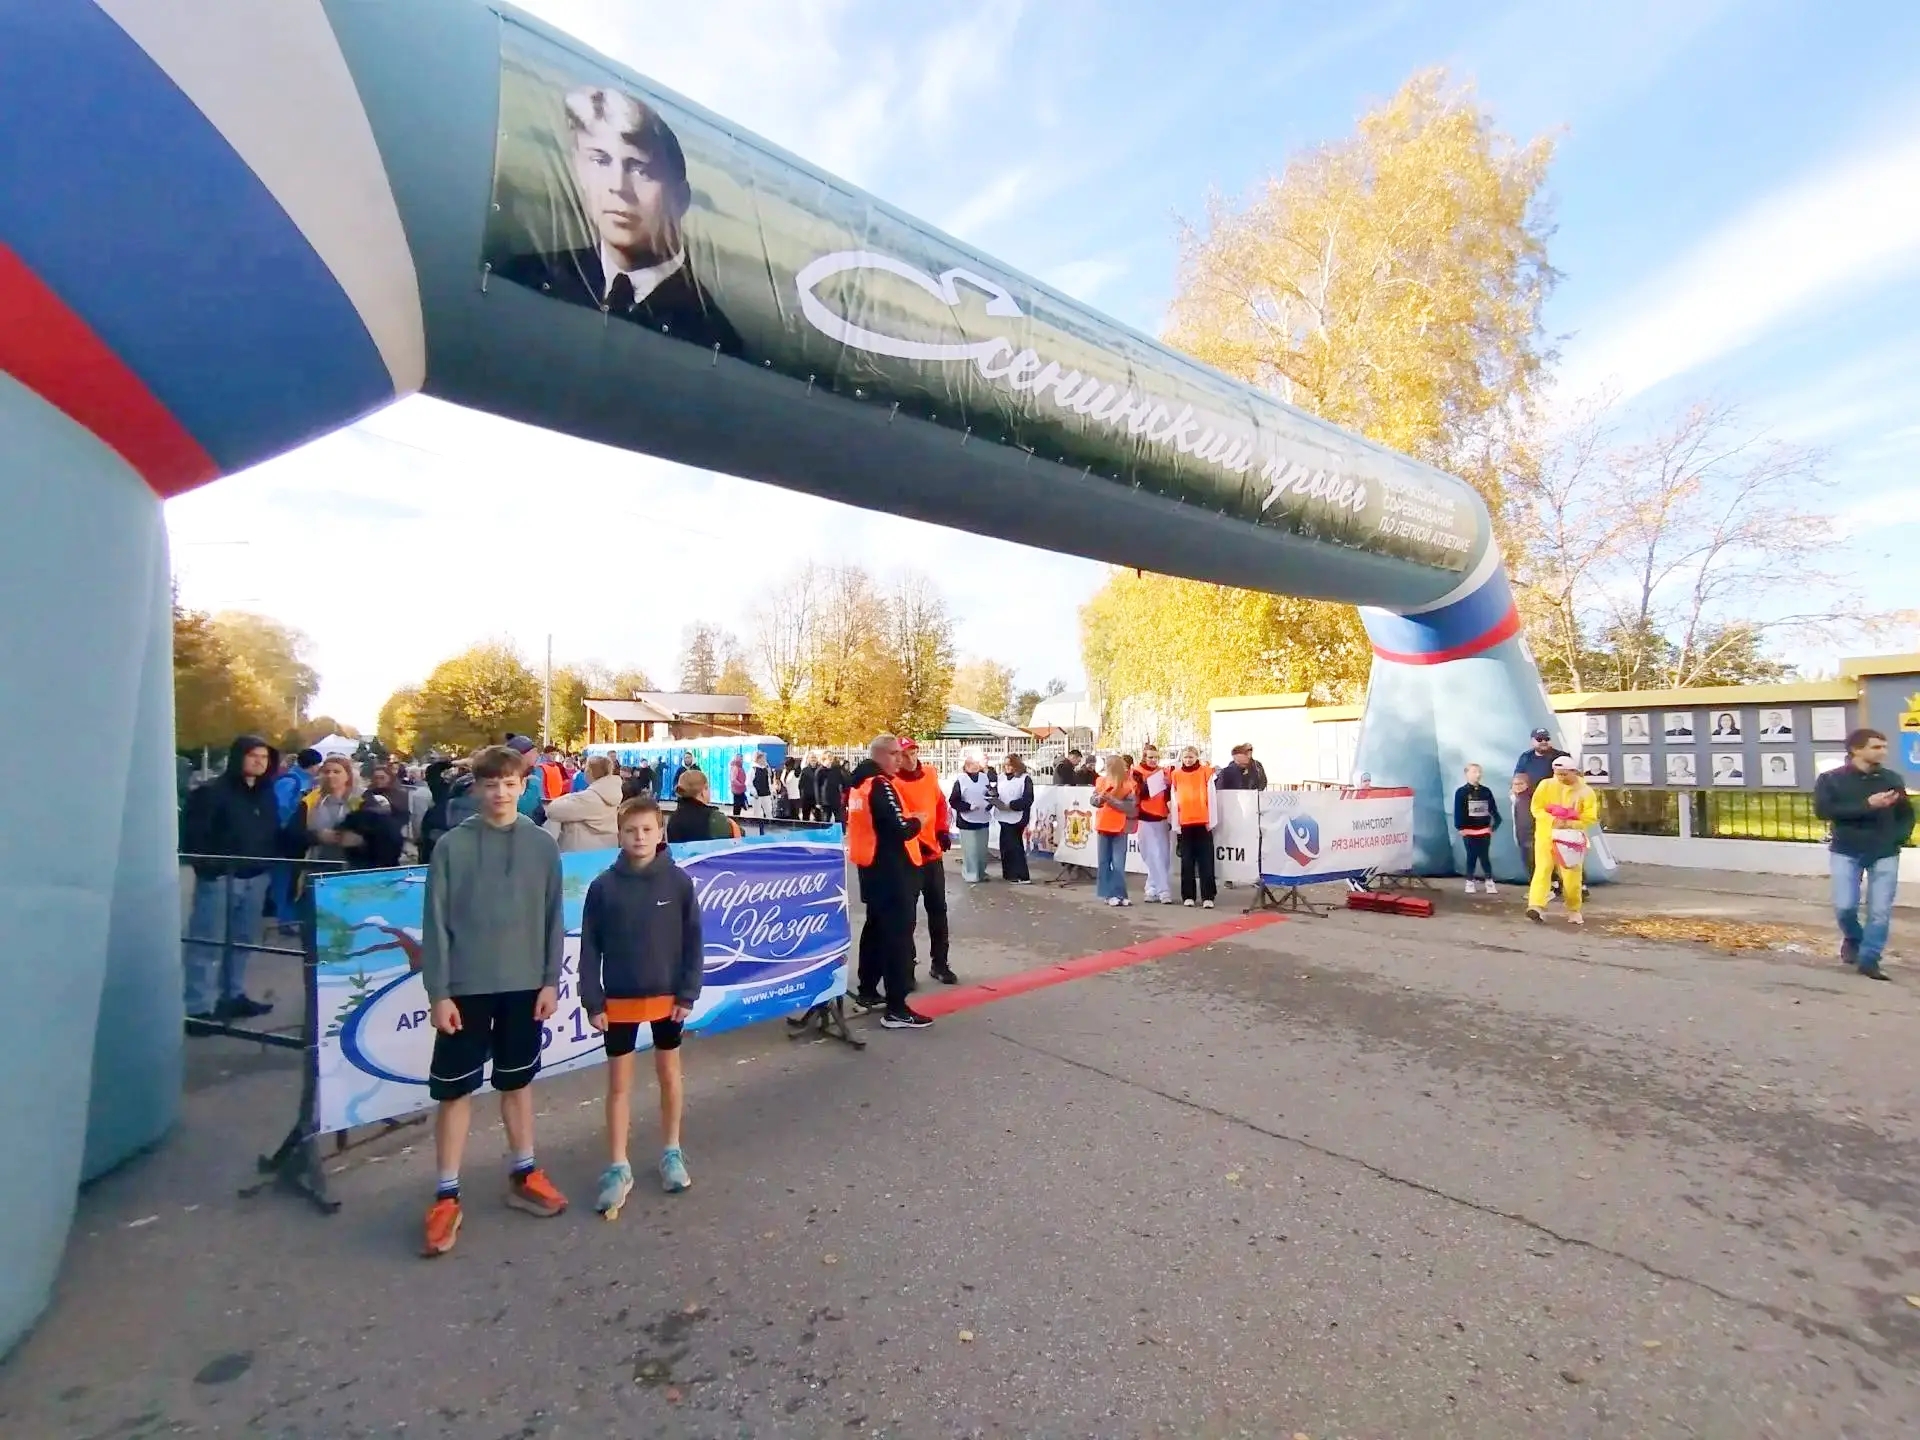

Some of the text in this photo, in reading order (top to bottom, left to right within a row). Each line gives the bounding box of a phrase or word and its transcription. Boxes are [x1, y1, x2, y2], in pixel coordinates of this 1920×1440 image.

[1383, 494, 1454, 529] СОРЕВНОВАНИЯ
[1378, 516, 1471, 553] ПО ЛЕГКОЙ АТЛЕТИКЕ
[1352, 817, 1393, 831] МИНСПОРТ
[1331, 832, 1408, 850] РЯЗАНСКАЯ ОБЛАСТЬ
[1215, 846, 1245, 861] СТИ
[717, 905, 829, 966] Звезда
[742, 981, 806, 1005] www.v-oda.ru
